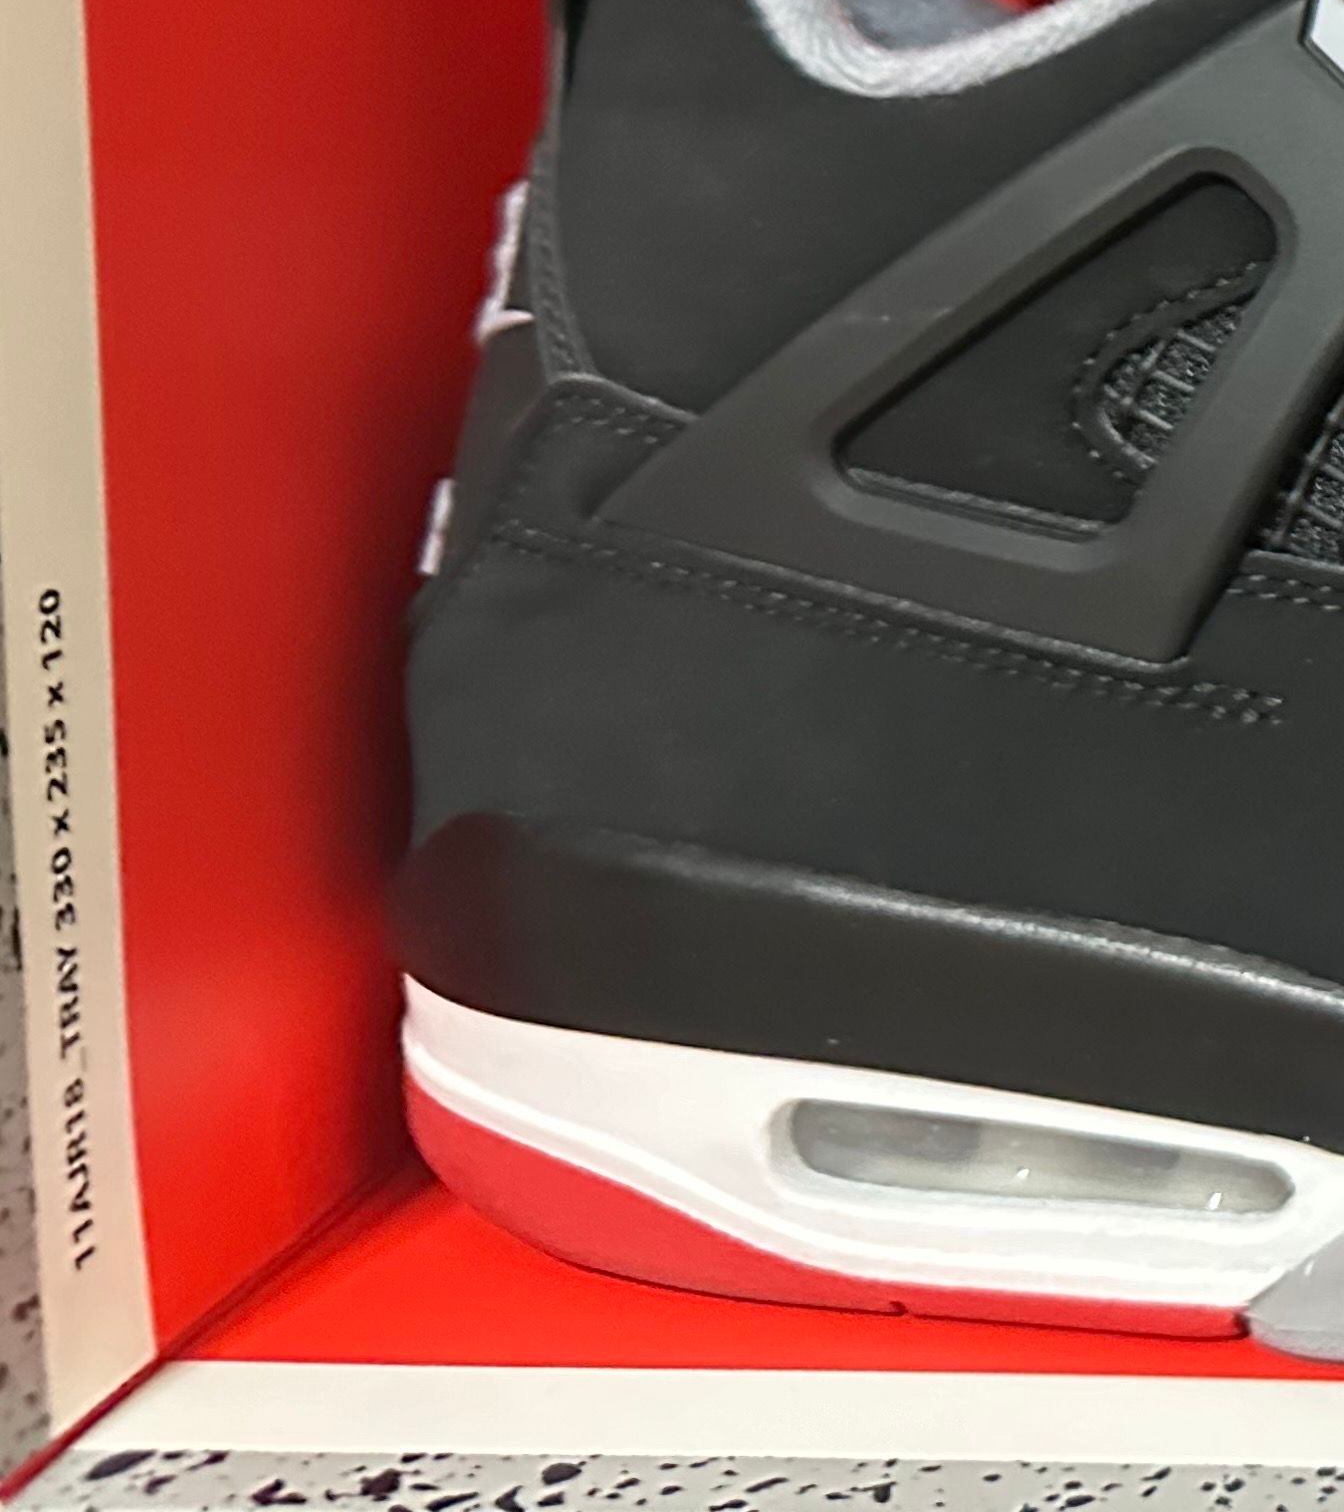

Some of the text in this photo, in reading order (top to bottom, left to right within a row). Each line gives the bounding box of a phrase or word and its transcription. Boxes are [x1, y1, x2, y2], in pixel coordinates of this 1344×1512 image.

[37, 587, 64, 672] 120
[43, 718, 69, 803] 235
[49, 845, 77, 932] 330
